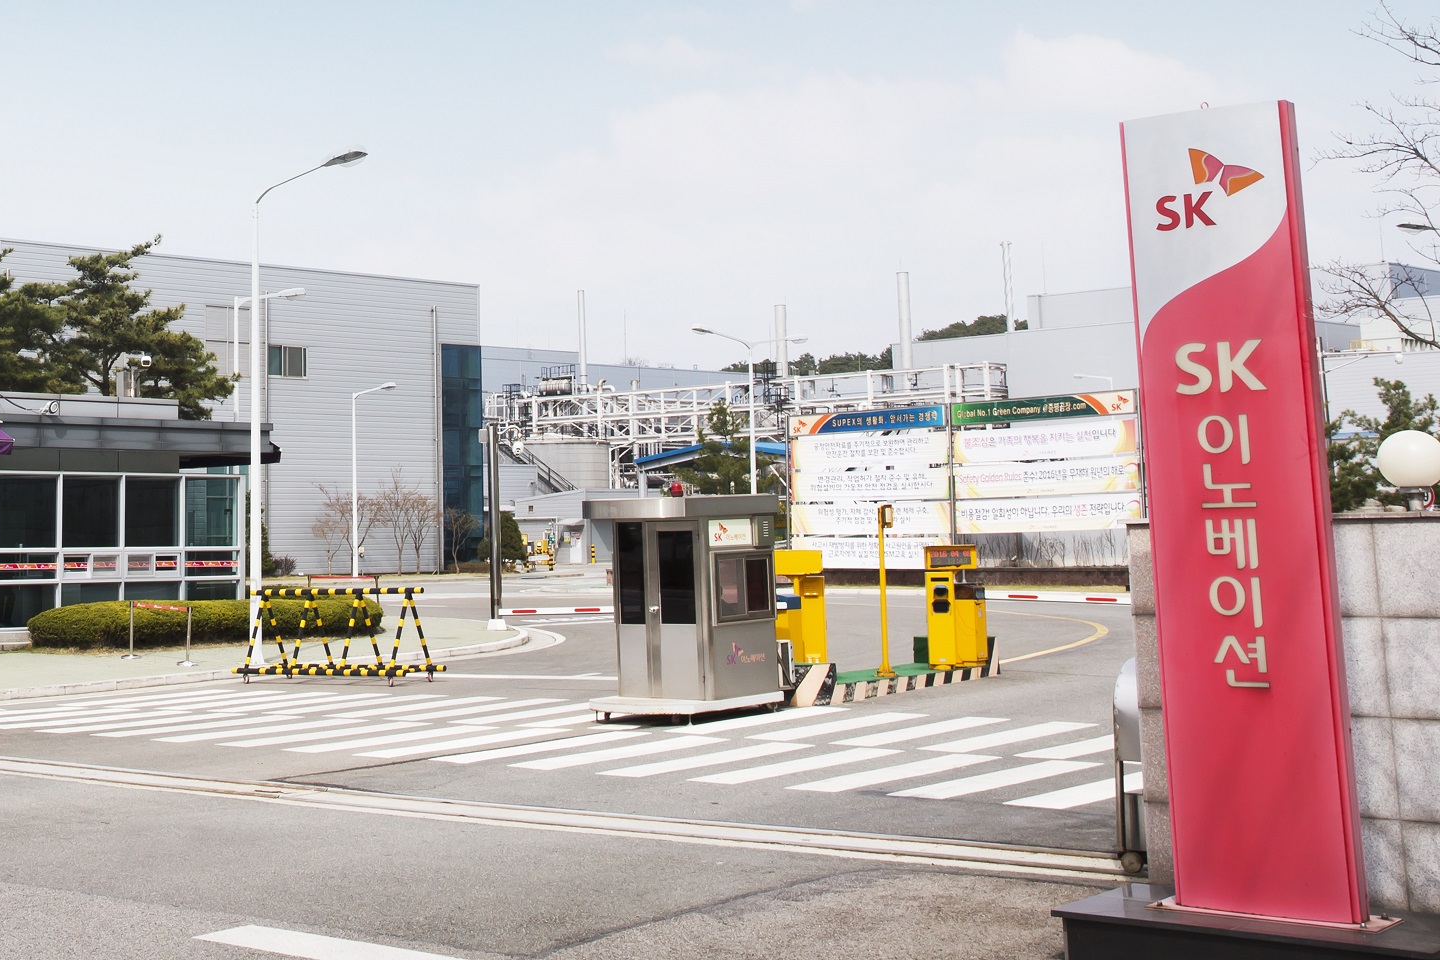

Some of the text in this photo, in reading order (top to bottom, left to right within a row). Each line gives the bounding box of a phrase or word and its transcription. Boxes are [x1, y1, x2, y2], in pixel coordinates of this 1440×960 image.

[1156, 191, 1217, 231] SK
[957, 408, 976, 418] Global
[977, 408, 991, 417] No.1
[992, 407, 1011, 416] Green
[1012, 406, 1041, 416] Company
[1111, 403, 1122, 411] SK
[832, 418, 863, 428] SUPEX의
[889, 414, 915, 424] 앞서가는
[793, 426, 802, 434] SK
[854, 440, 881, 449] 주기적으로
[907, 437, 929, 446] 관리하고
[964, 436, 997, 449] 불조심은
[998, 435, 1023, 447] 가족의
[1023, 434, 1048, 446] 행복을
[1049, 432, 1075, 442] 지키는
[826, 450, 848, 458] 안전운전
[850, 449, 866, 458] 절차를
[847, 475, 872, 483] 작업허가
[889, 474, 901, 482] 준수
[959, 465, 1124, 485] Safety Golden Rules 준수! 2016년을 무재해 원년의 해로
[818, 508, 834, 516] 위험성
[991, 507, 1019, 520] 일회성이
[1051, 504, 1072, 516] 우리의
[1073, 503, 1088, 515] 생존
[1175, 339, 1270, 688] SK 이노베이션
[836, 516, 852, 524] 주기적
[854, 516, 865, 525] 점검
[900, 516, 911, 524] 실시
[713, 532, 723, 542] SK
[856, 541, 867, 550] 위한
[726, 654, 737, 666] SK
